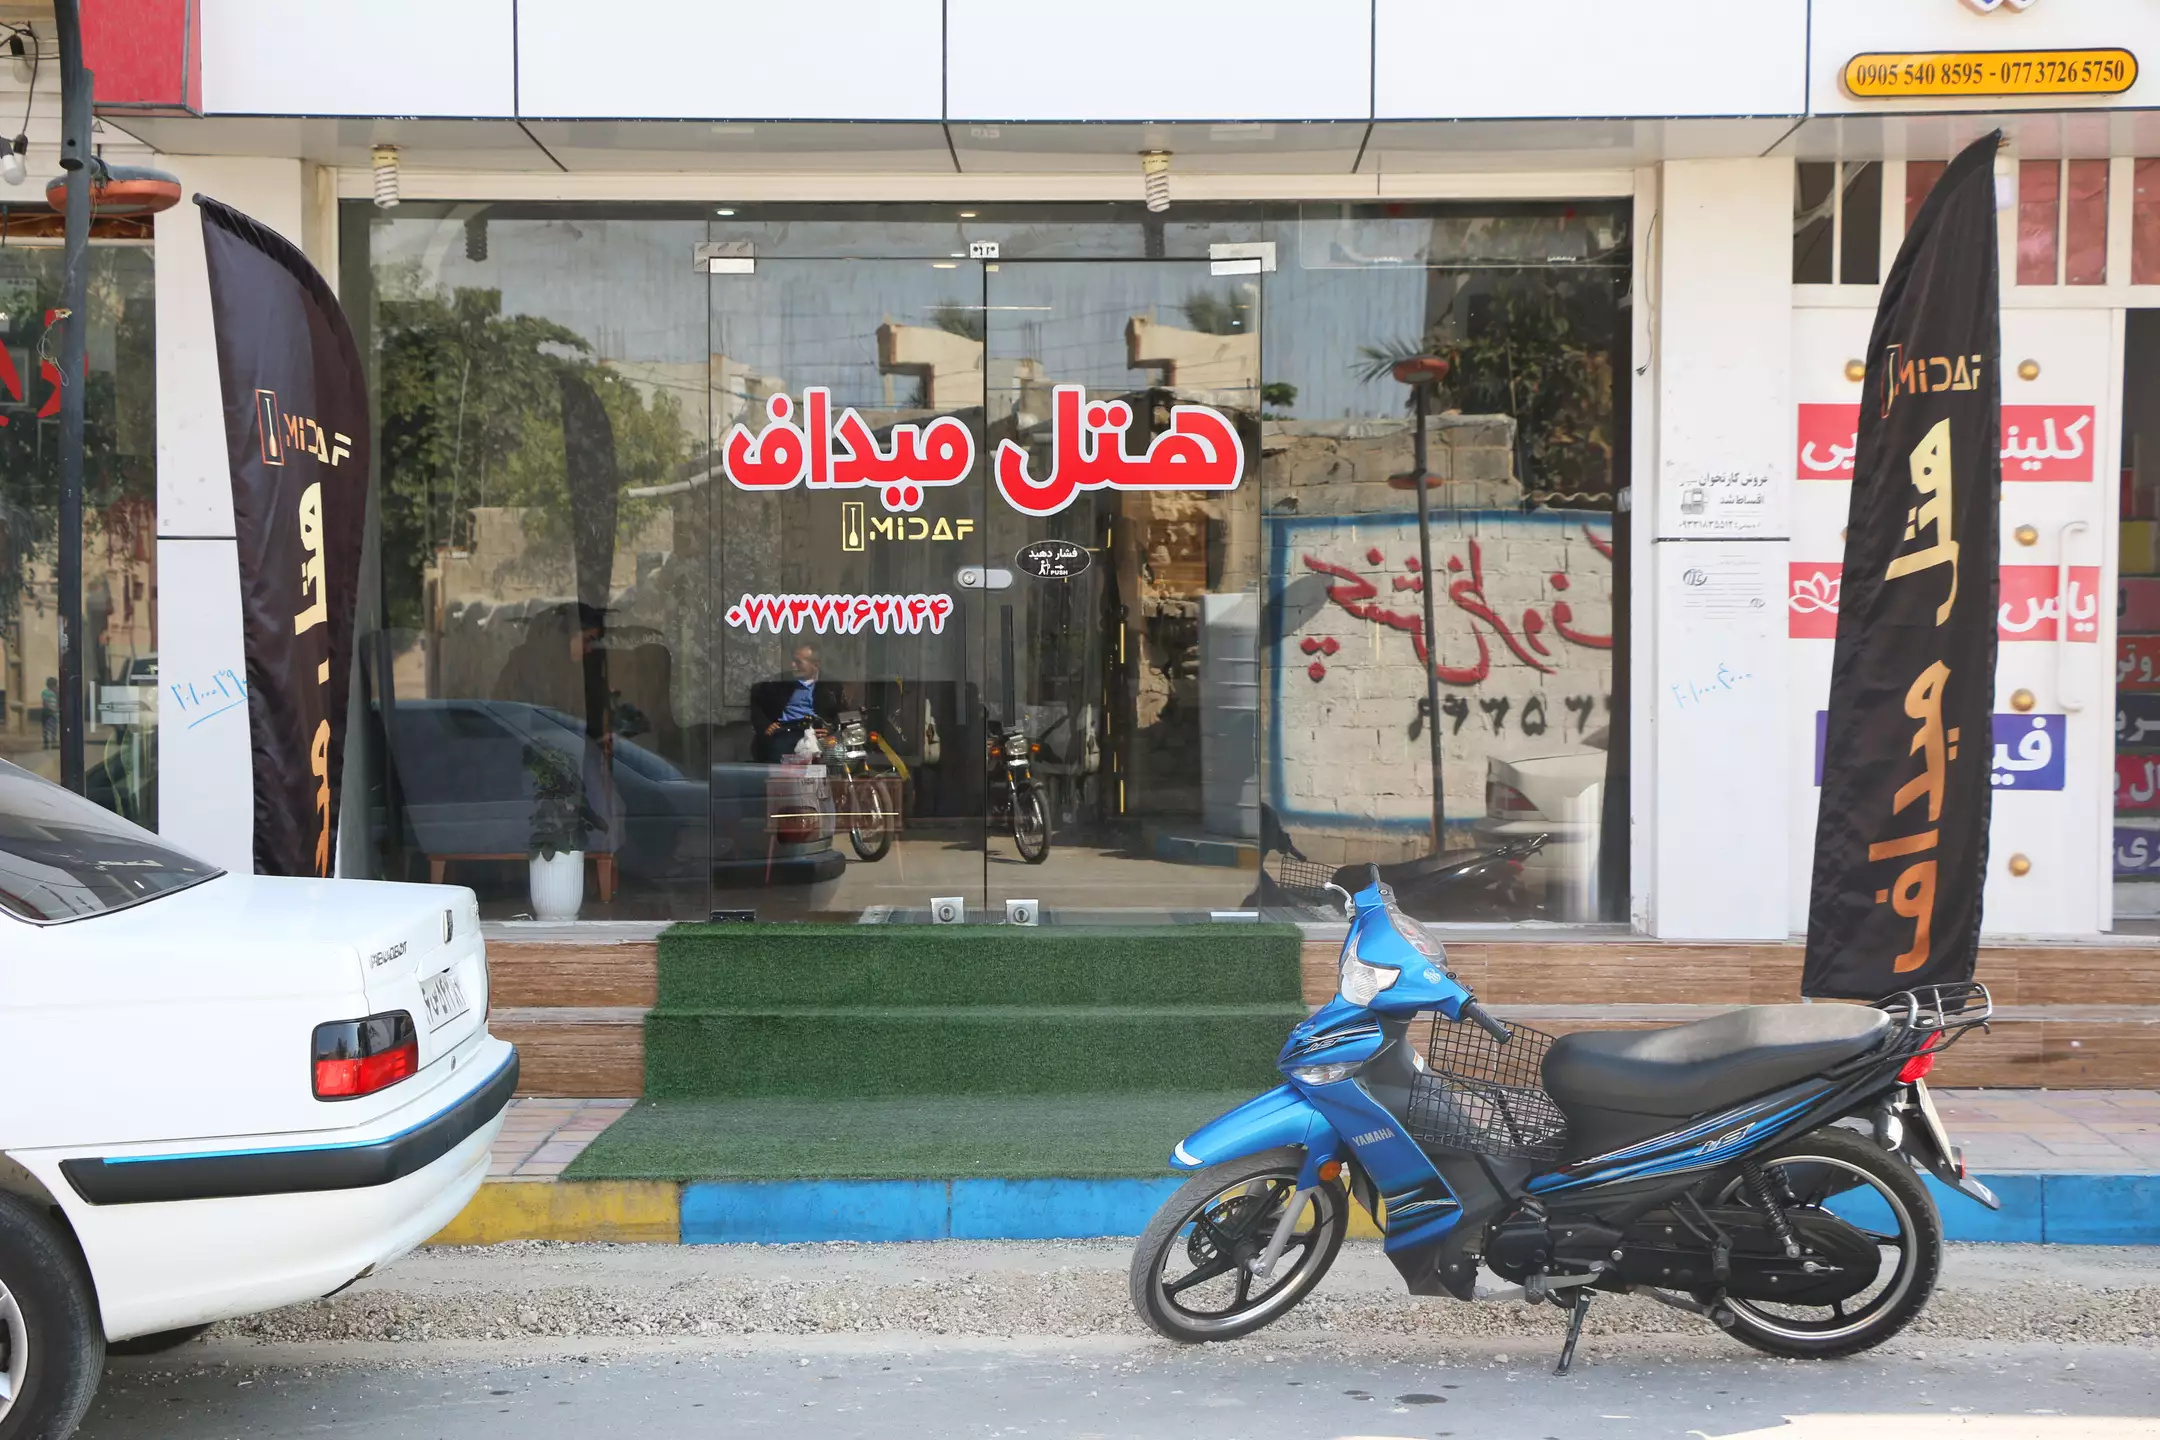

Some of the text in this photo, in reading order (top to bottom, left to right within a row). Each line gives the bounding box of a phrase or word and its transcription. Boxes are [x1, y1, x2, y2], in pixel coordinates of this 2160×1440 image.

[1857, 64, 1898, 86] 0905
[1904, 63, 1935, 85] 540
[1940, 62, 1983, 85] 8595
[2081, 60, 2124, 82] 5750
[723, 384, 1244, 516] هتل میداف
[1028, 547, 1078, 561] فشار دهید
[724, 593, 954, 635] ۰۷۷۳۷۲۶۲۱۴۴
[1868, 416, 1960, 974] هتل میداف
[1351, 1127, 1396, 1147] YAMAHA
